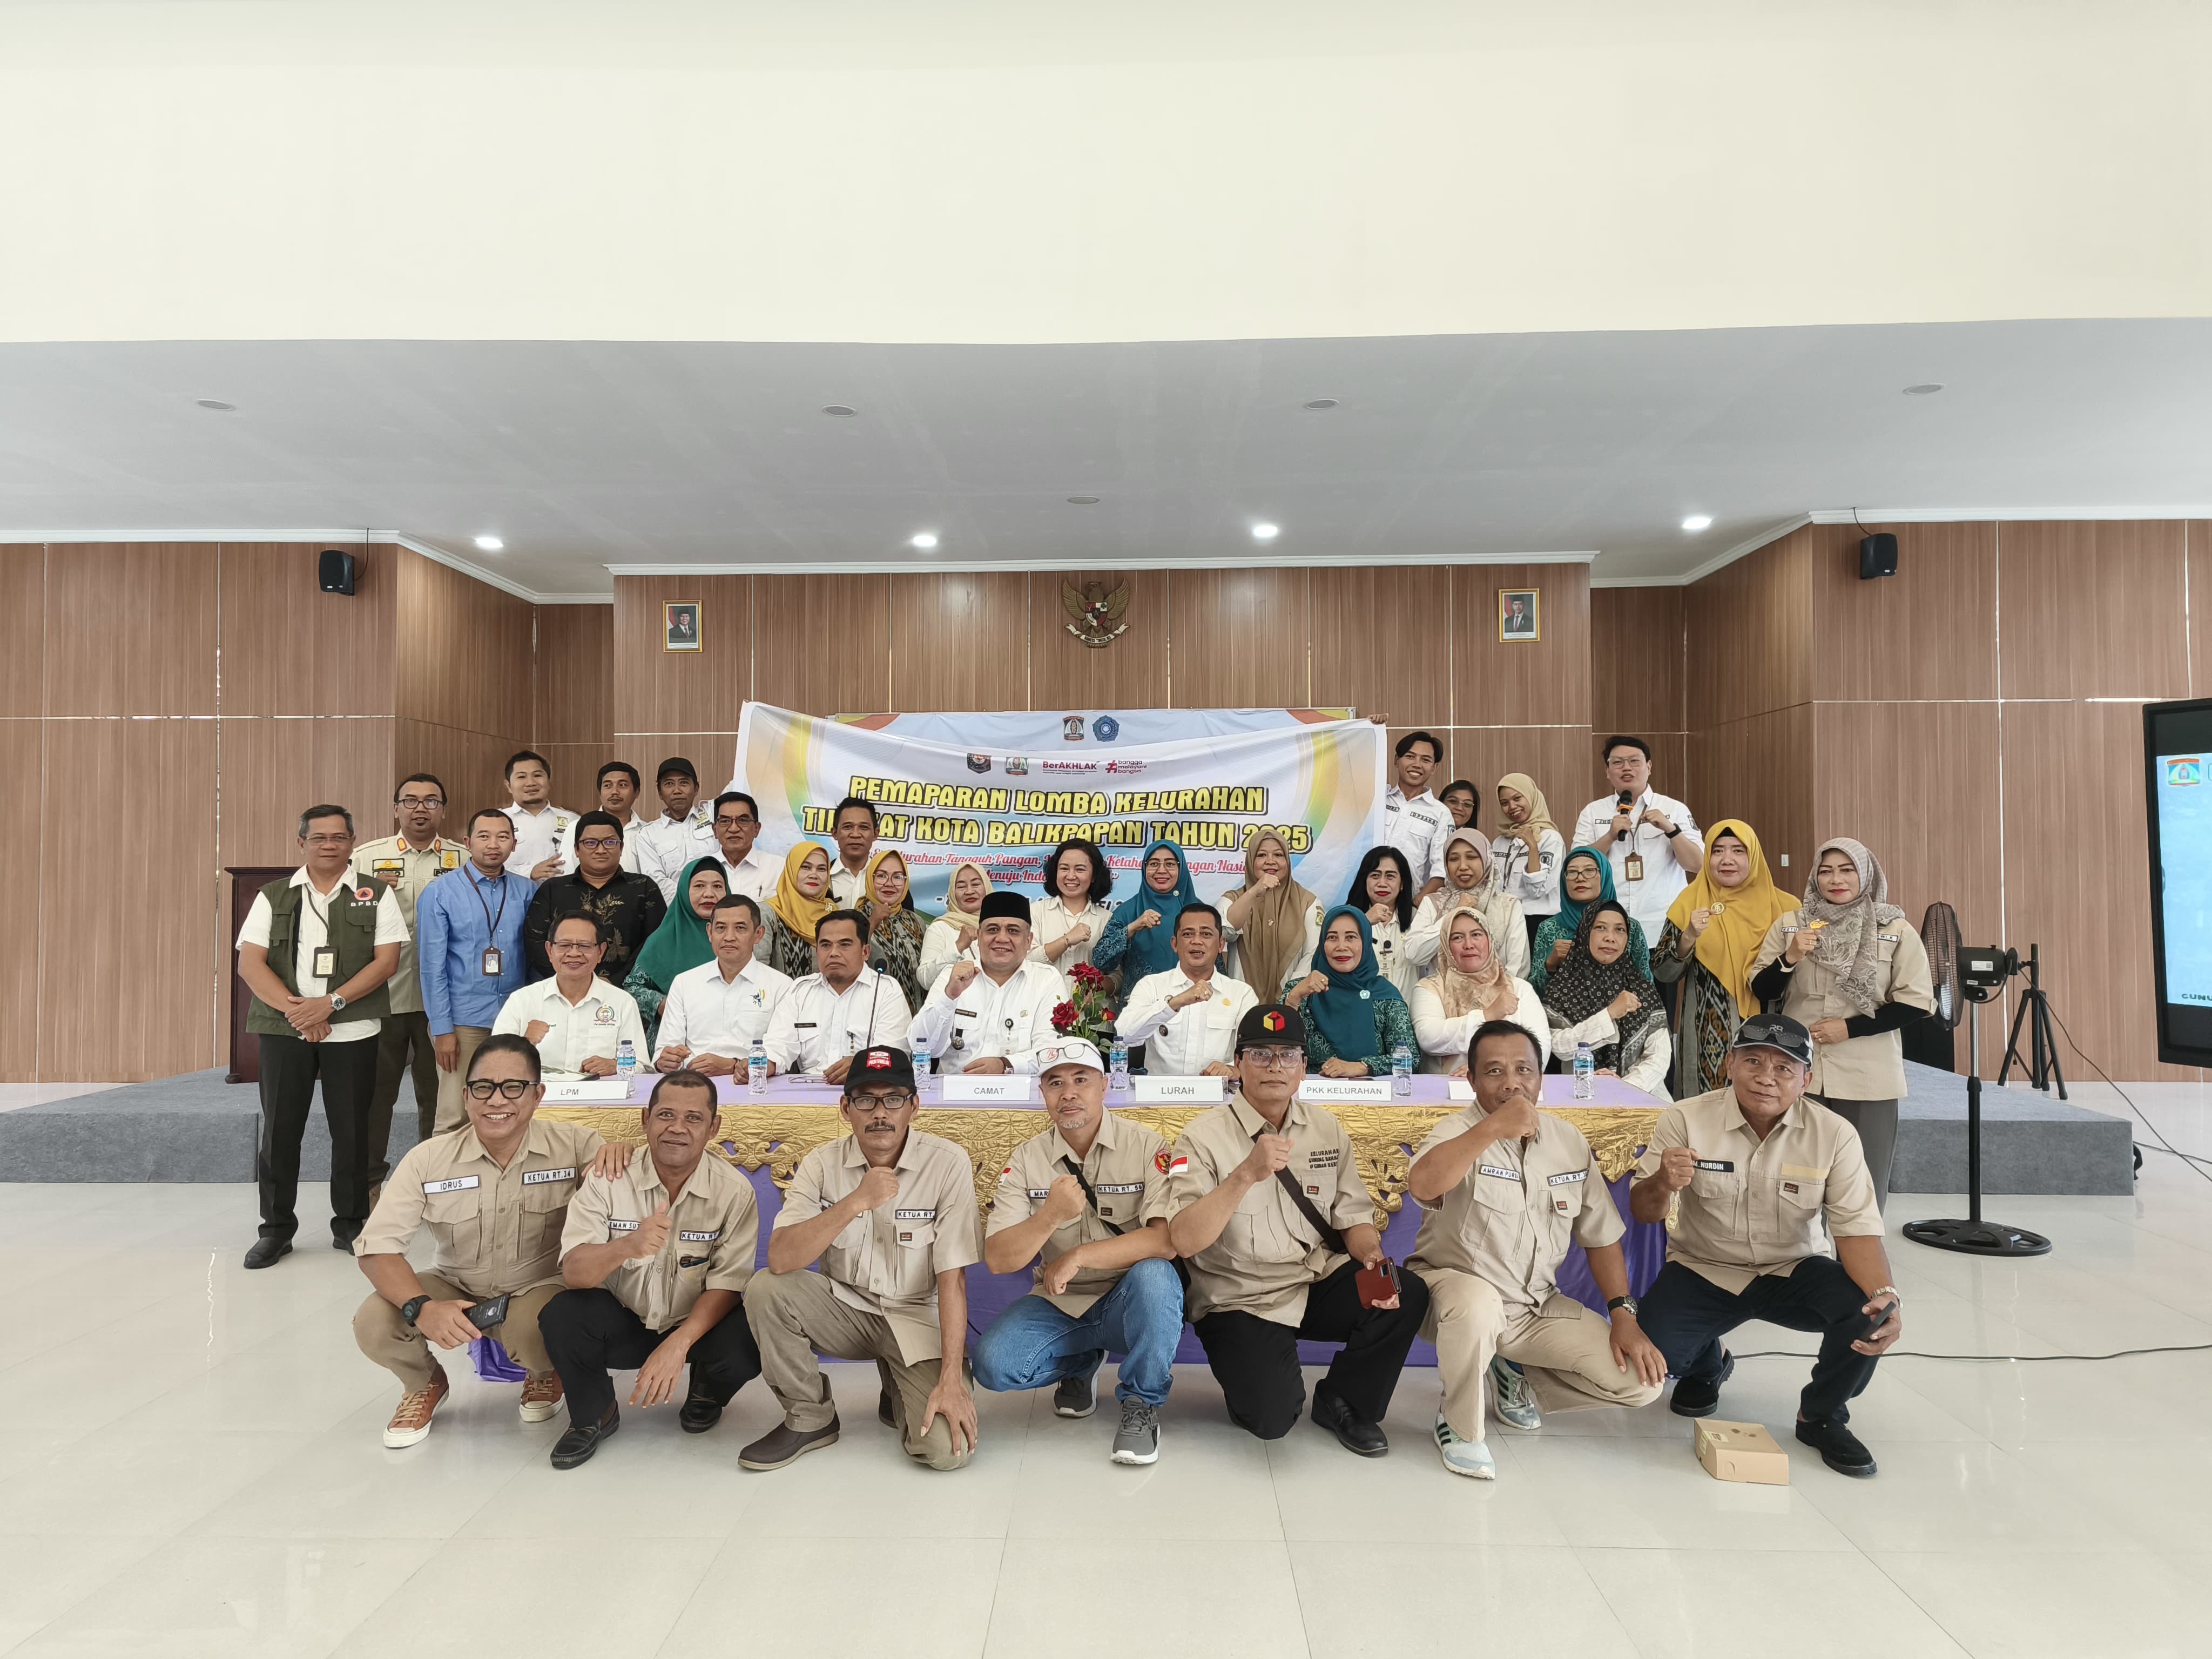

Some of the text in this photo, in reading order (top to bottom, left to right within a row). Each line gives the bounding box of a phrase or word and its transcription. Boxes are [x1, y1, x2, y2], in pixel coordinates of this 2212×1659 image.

[1043, 761, 1097, 770] BerAKHLAK
[850, 775, 1265, 815] PEMAPARAN LOMBA KELURAHAN
[802, 806, 1309, 851] TIAT KOTA BALIKPAPAN TAHUN 225
[995, 853, 1041, 867] Pangan,
[1186, 862, 1214, 873] ngan
[1217, 860, 1245, 872] Nasi
[561, 1088, 579, 1096] LPM
[1161, 1086, 1195, 1095] LURAH
[1306, 1086, 1382, 1095] PKK KELURAHAN
[1483, 1168, 1504, 1176] AMRAN
[528, 1172, 550, 1182] KETUA
[1550, 1176, 1570, 1184] KETUA
[440, 1181, 463, 1191] IDRUS
